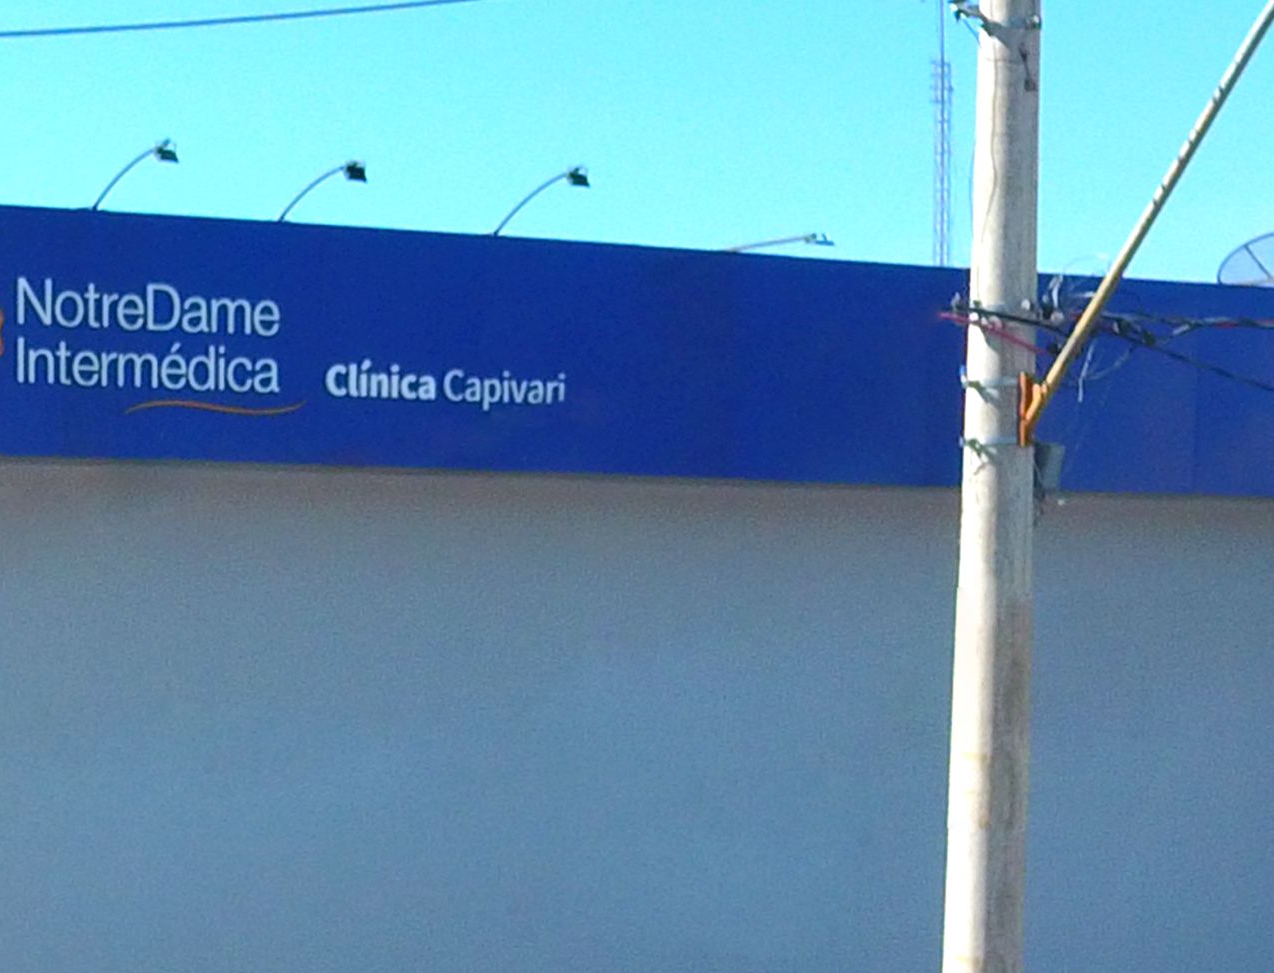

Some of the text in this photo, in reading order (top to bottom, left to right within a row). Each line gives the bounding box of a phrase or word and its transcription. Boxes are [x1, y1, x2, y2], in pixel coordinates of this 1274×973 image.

[17, 277, 280, 337] NotreDame
[17, 336, 280, 393] Intermédica
[326, 359, 567, 411] Clínica Capivari
